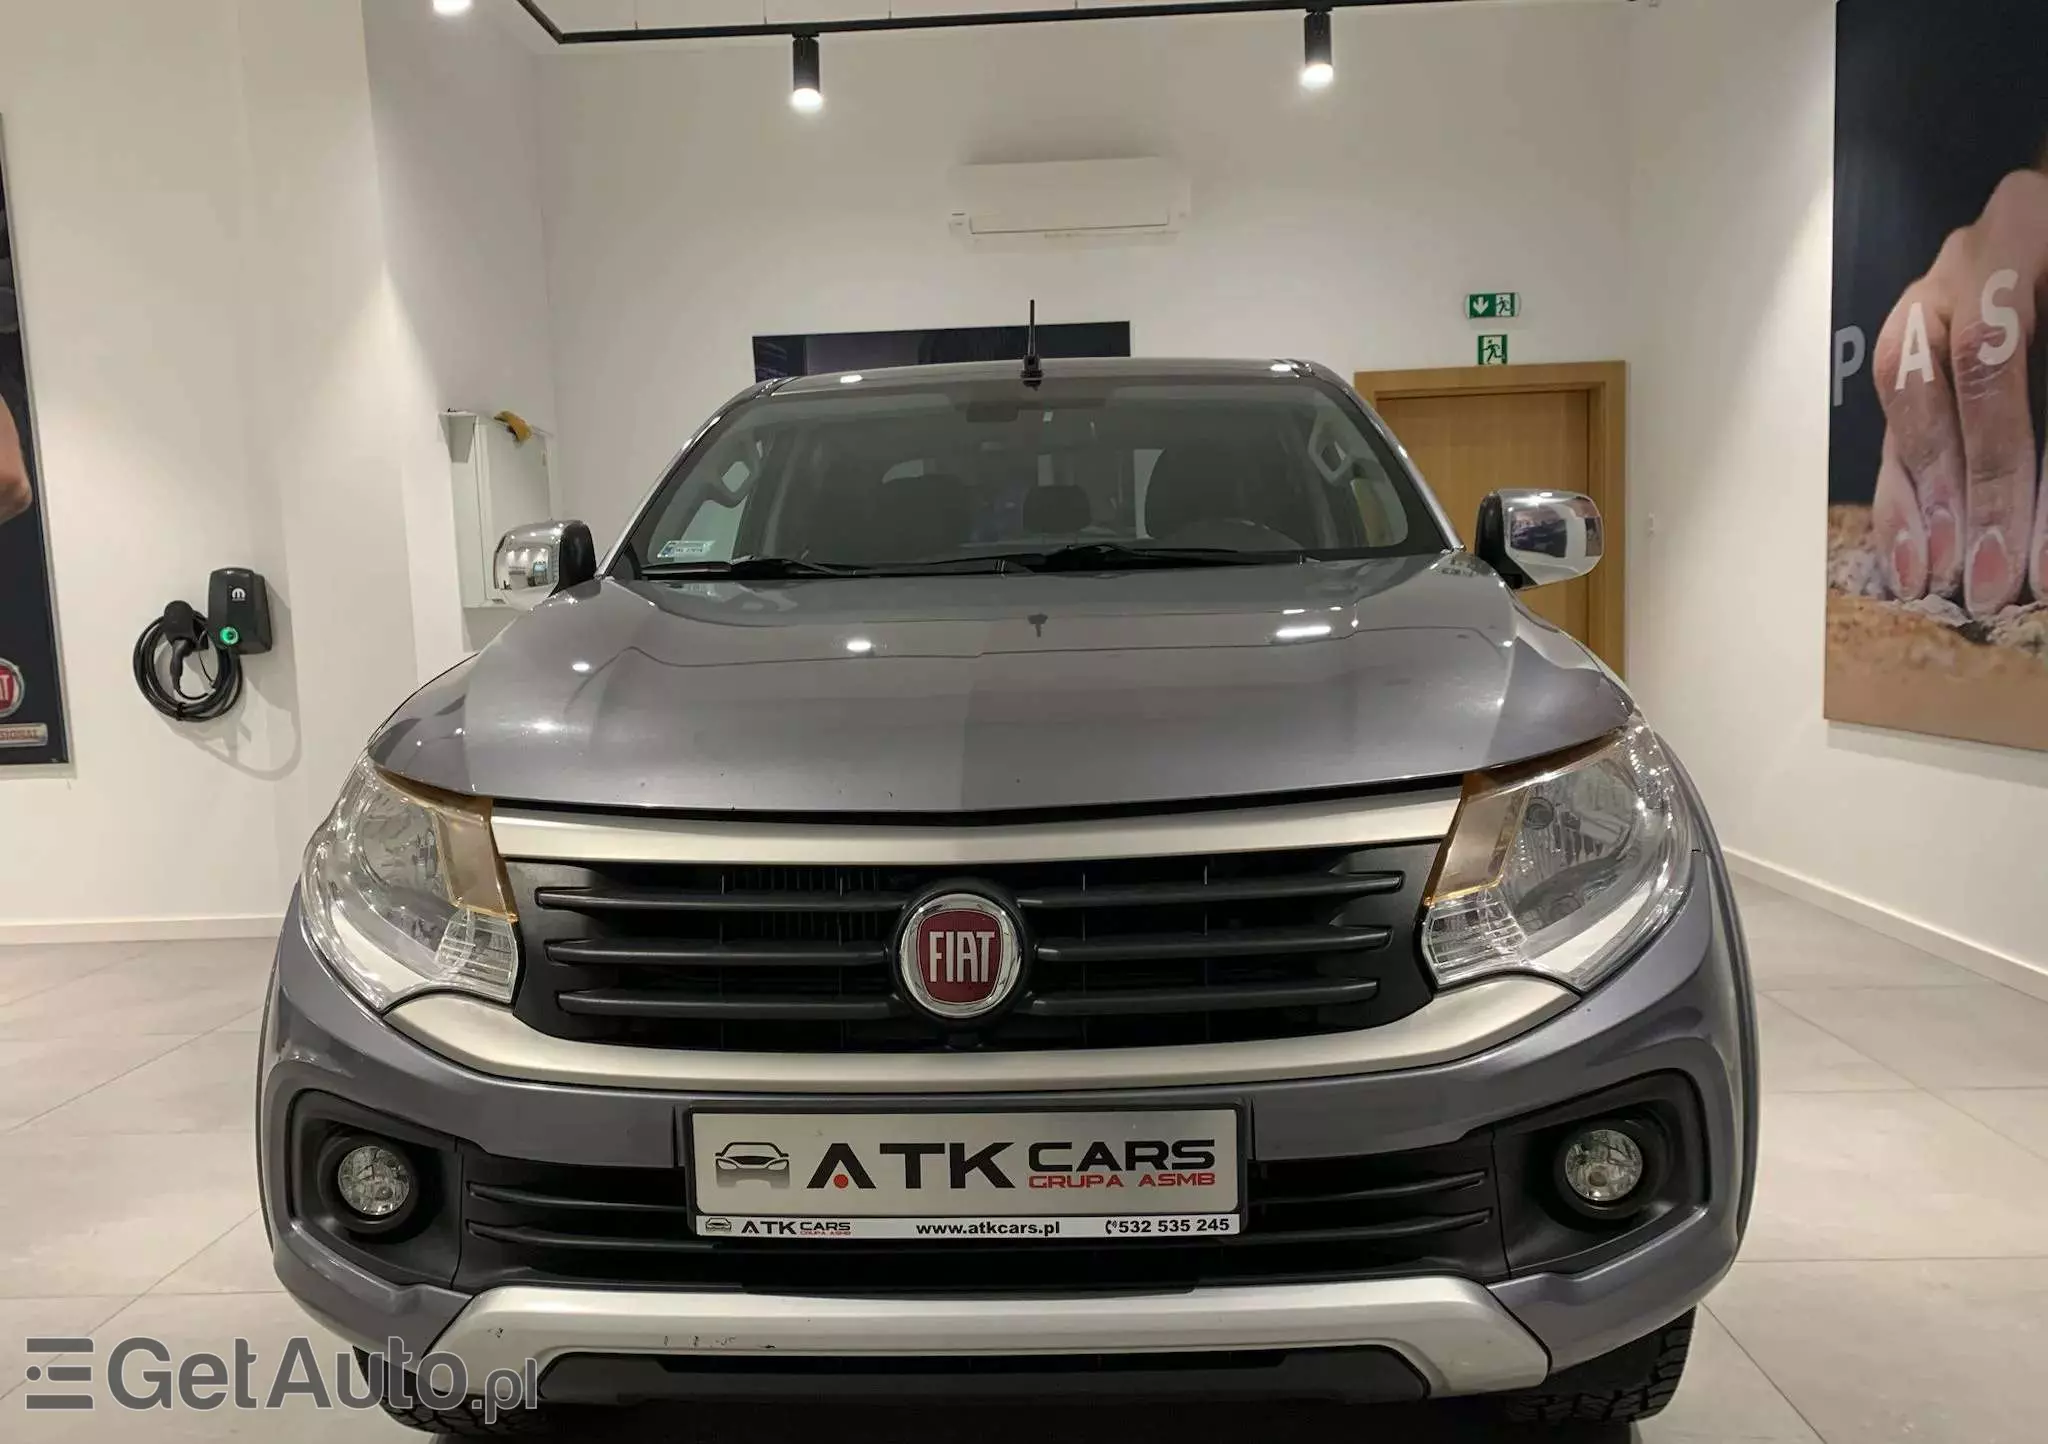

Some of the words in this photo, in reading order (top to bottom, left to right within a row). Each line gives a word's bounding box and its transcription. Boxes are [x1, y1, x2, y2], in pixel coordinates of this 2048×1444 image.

[929, 931, 995, 983] FIAT
[806, 1142, 1015, 1190] ATK
[1028, 1139, 1215, 1173] CARS
[1028, 1174, 1124, 1189] GRUPA
[1138, 1172, 1216, 1187] ASMB
[741, 1220, 797, 1236] ATK
[800, 1221, 851, 1231] CARS
[916, 1221, 1060, 1237] www.atkcars.pl
[1119, 1220, 1151, 1234] 532
[1158, 1219, 1190, 1233] 535
[1197, 1218, 1230, 1232] 245
